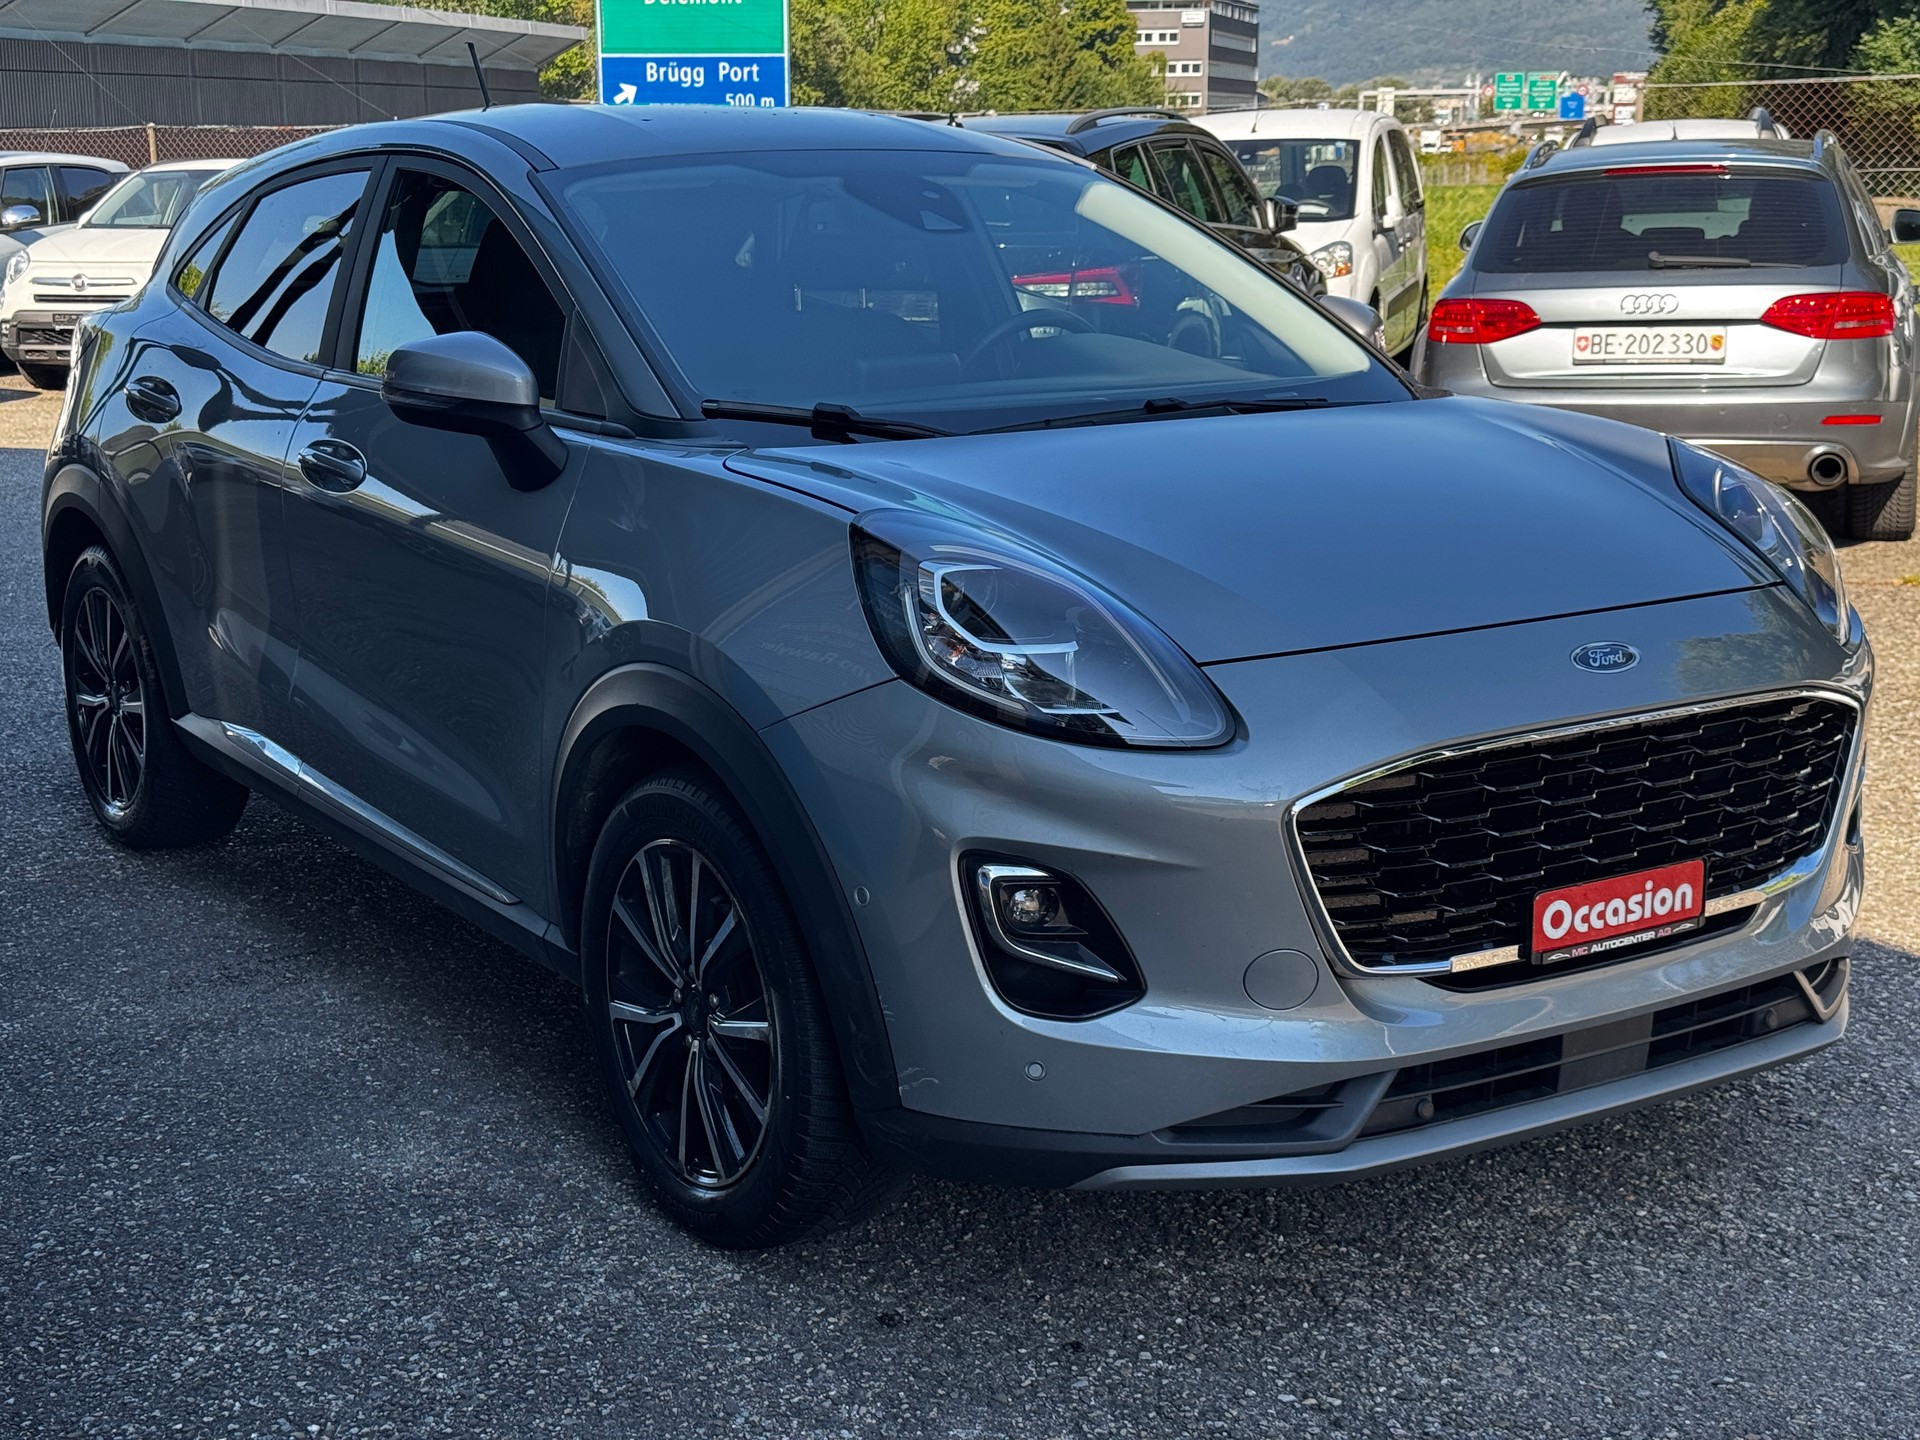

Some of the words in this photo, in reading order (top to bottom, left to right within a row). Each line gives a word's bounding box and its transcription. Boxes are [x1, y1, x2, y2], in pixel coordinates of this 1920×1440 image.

[646, 61, 705, 88] Brügg
[718, 61, 760, 83] Port
[725, 93, 755, 107] 500
[1588, 648, 1627, 667] Ford
[1542, 879, 1693, 940] Occasion
[1571, 946, 1589, 958] MC
[1590, 930, 1656, 954] AUTOCENTER
[1657, 927, 1672, 938] AG
